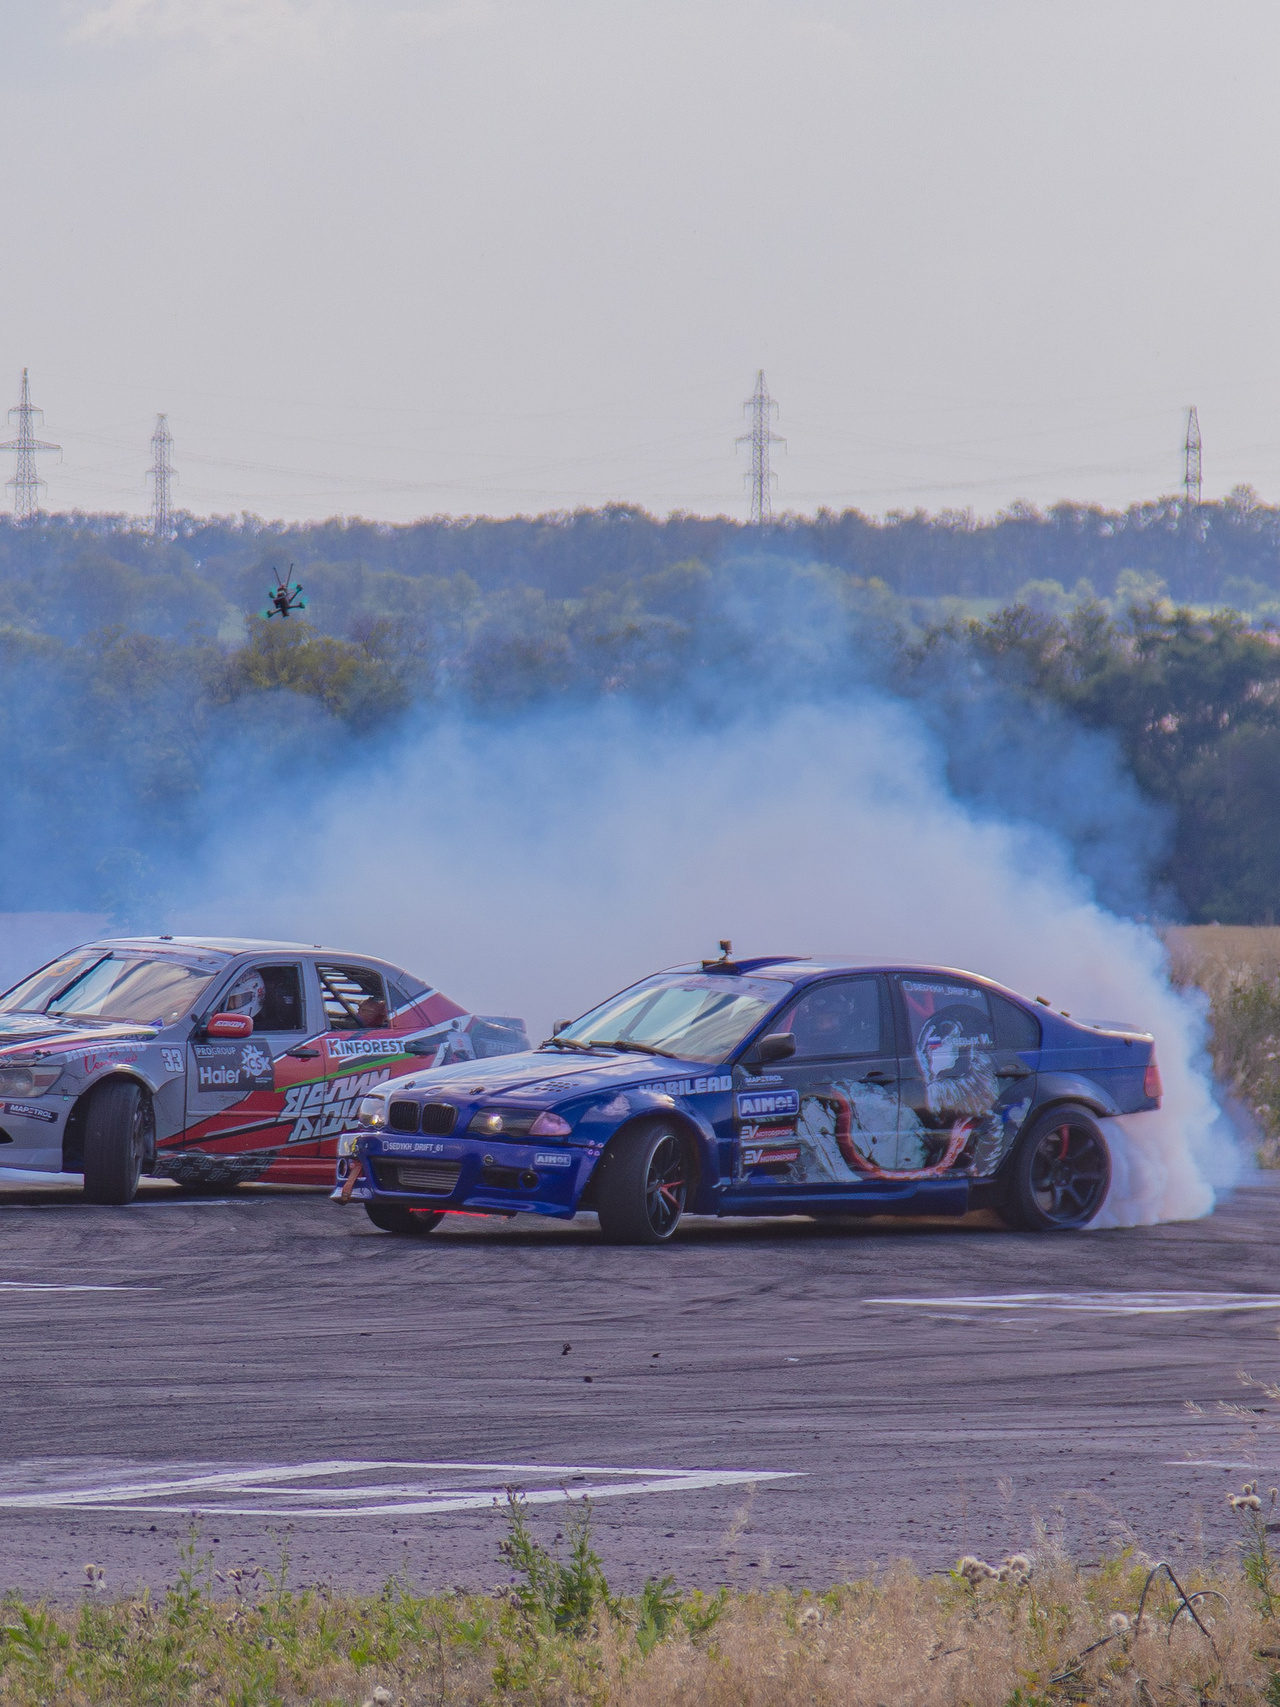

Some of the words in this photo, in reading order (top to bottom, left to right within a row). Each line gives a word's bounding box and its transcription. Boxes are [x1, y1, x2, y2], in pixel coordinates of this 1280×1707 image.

[326, 1039, 405, 1057] KINFOREST
[160, 1047, 185, 1073] 33
[248, 1056, 273, 1071] CSK
[200, 1065, 240, 1084] Haier
[741, 1096, 796, 1114] AIMOL
[740, 1125, 760, 1139] EV
[755, 1129, 793, 1138] MOTORSPORT
[389, 1142, 444, 1153] SEDYKH_DRIFT_61
[537, 1155, 569, 1164] AIMOL
[744, 1150, 763, 1164] EV
[760, 1153, 798, 1163] MOTORSPORT
